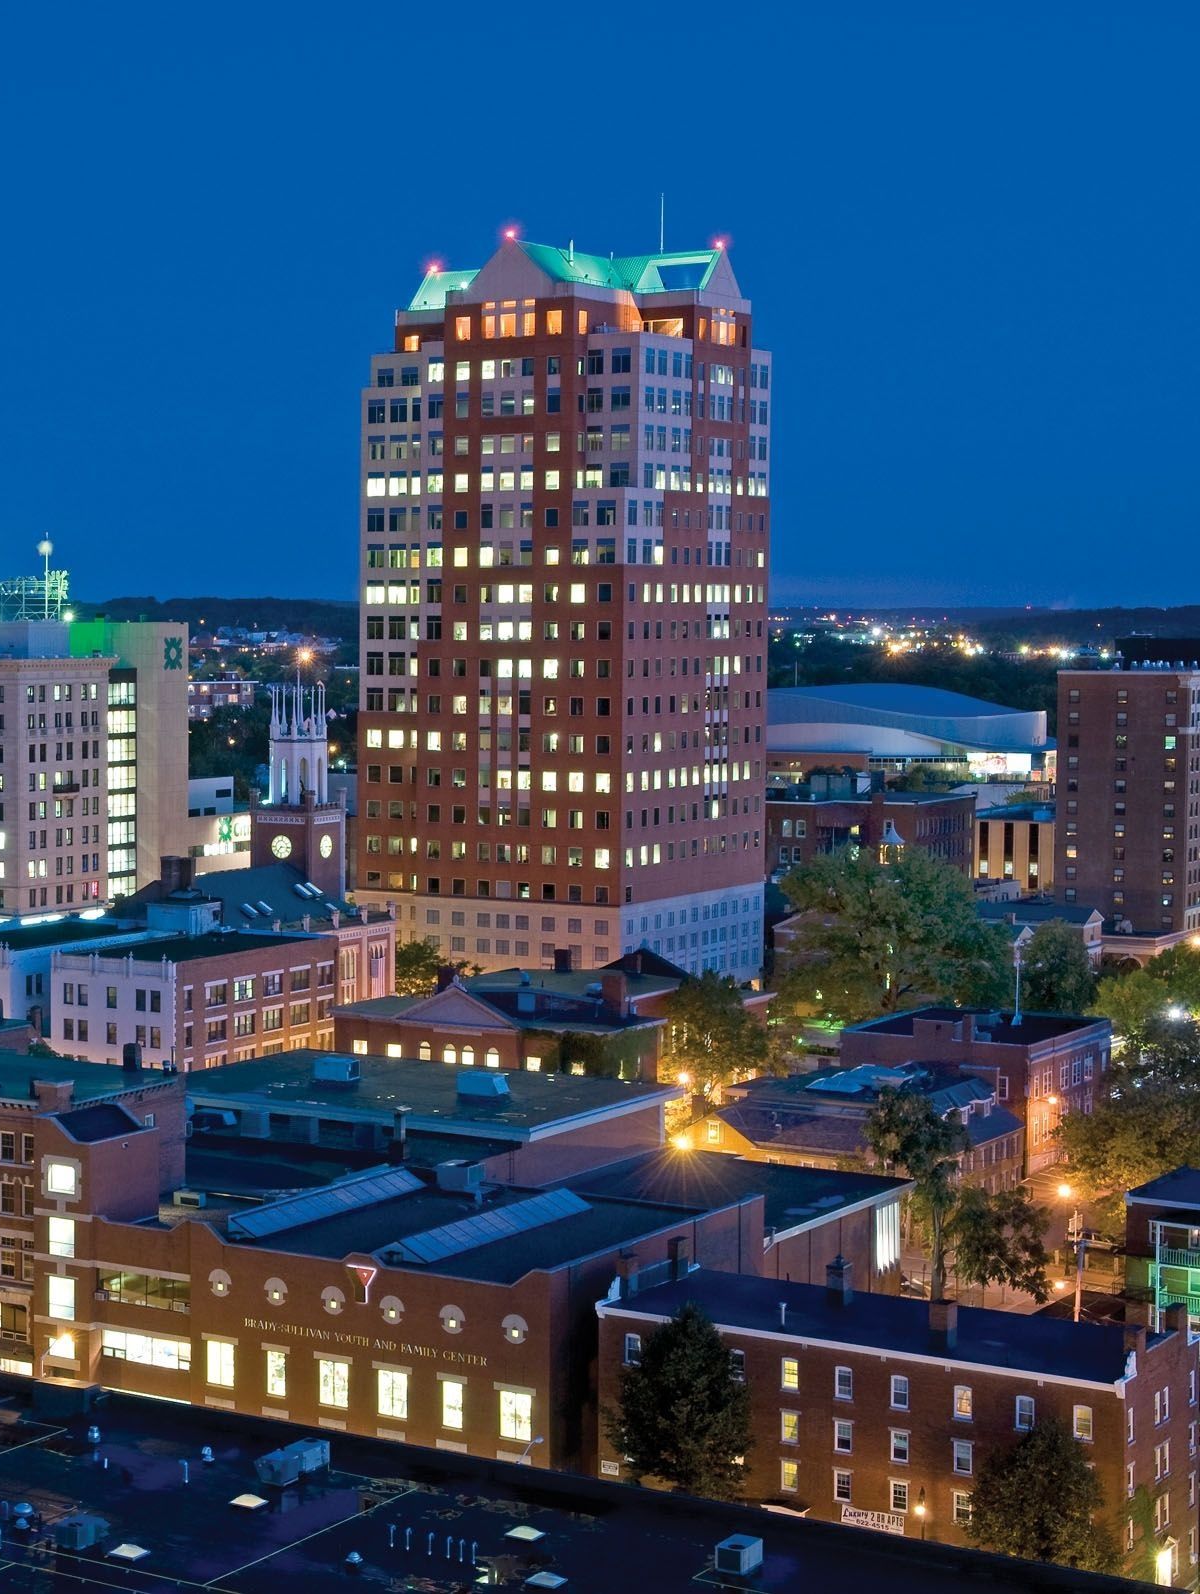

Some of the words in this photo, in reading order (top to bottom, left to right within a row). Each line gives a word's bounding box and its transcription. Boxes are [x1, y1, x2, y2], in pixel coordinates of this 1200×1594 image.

[244, 1318, 330, 1340] BRADY-SULLIVAN
[334, 1331, 370, 1347] YOUTH
[373, 1338, 397, 1351] AND
[400, 1343, 439, 1359] FAMILY
[443, 1350, 487, 1367] CENTER
[843, 1508, 868, 1519] Luxury
[870, 1512, 875, 1522] 2
[887, 1515, 903, 1527] APTS
